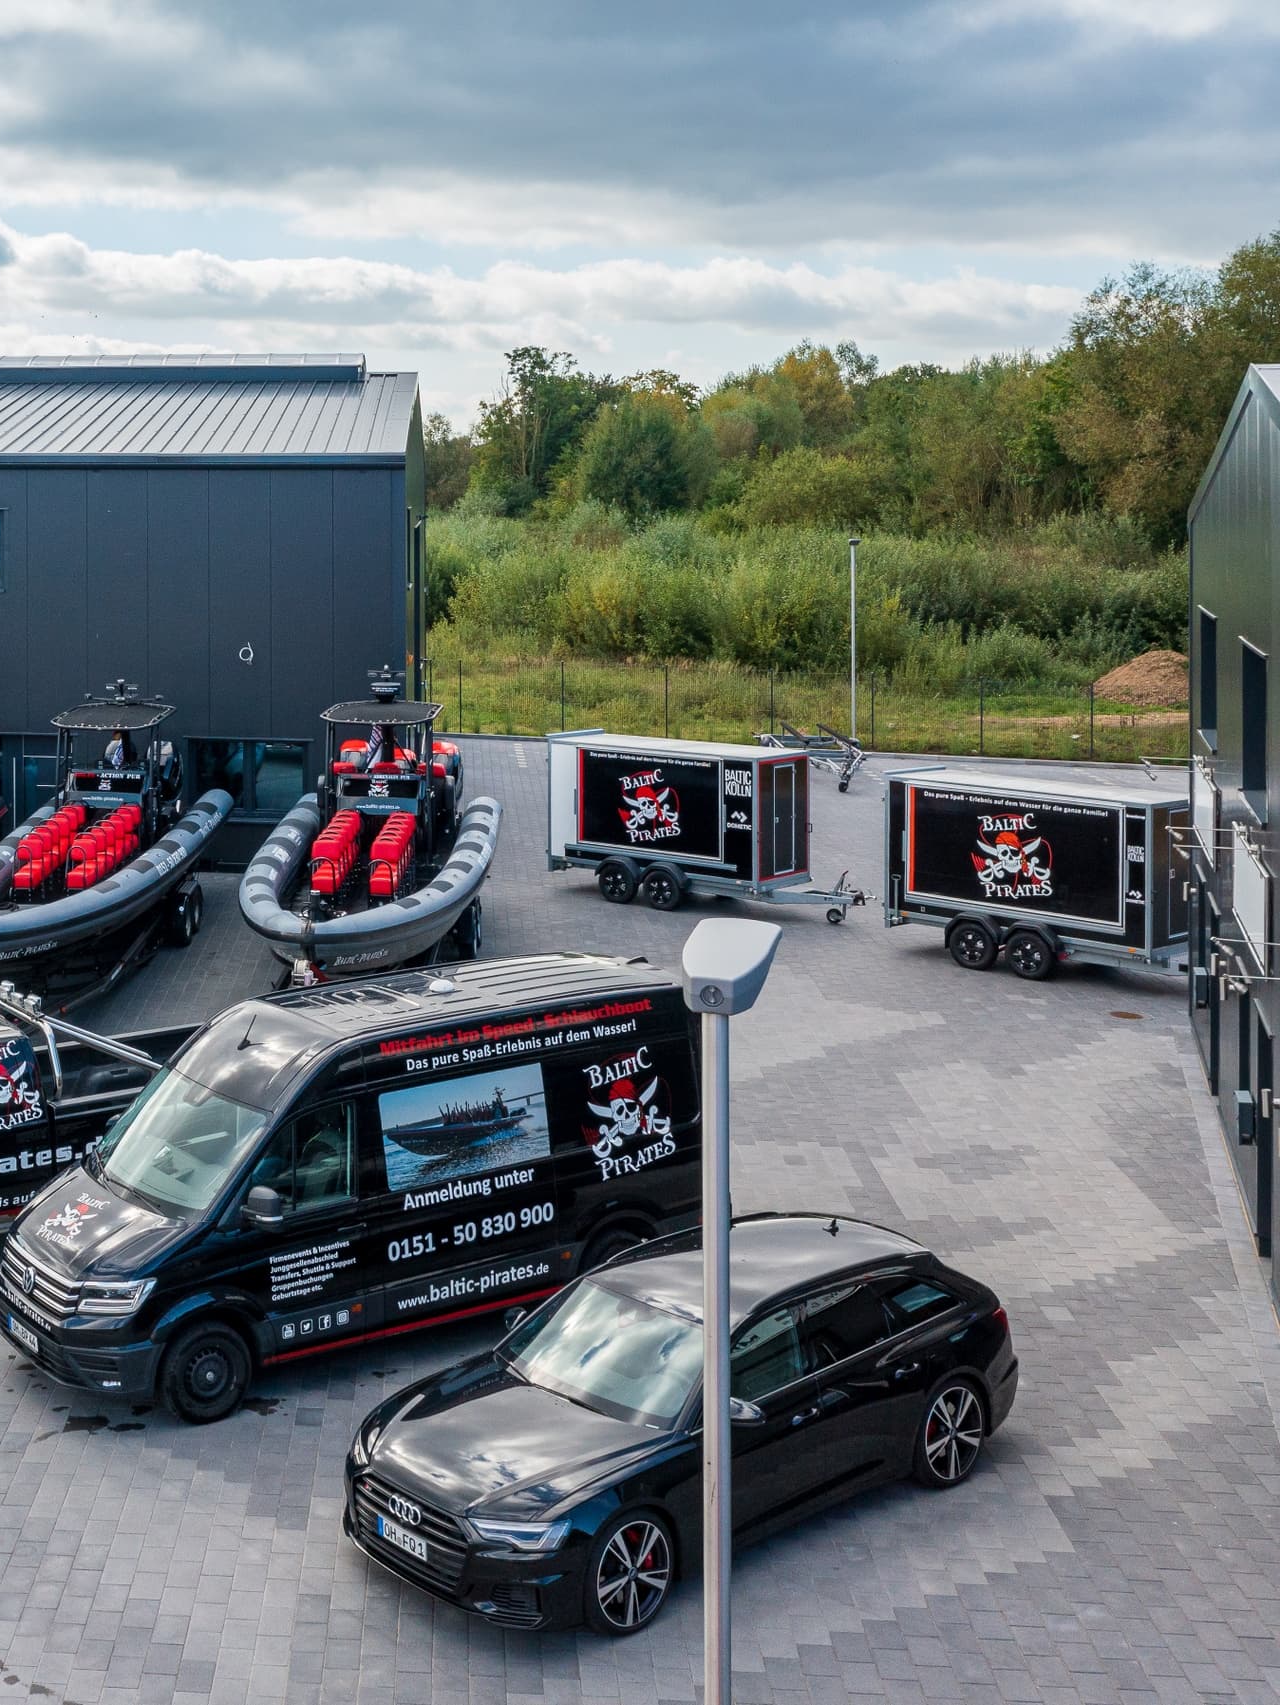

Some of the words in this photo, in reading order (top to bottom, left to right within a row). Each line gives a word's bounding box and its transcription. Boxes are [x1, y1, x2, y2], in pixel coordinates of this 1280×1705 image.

[618, 768, 665, 791] BALTIC
[724, 769, 752, 785] BALTIC
[924, 790, 935, 798] Das
[936, 792, 949, 800] pure
[1019, 801, 1041, 810] Wasser
[1052, 804, 1062, 812] die
[1083, 808, 1108, 817] Familie!
[626, 822, 681, 843] PIRATES
[977, 813, 1037, 832] BALTIC
[979, 880, 1053, 899] PIRATES
[379, 1033, 454, 1057] Mitfahrt
[457, 1029, 480, 1043] im
[482, 1017, 534, 1040] Speed
[544, 998, 652, 1028] Schlauchboot
[406, 1056, 428, 1071] Das
[432, 1052, 460, 1069] pure
[462, 1036, 542, 1062] Spaß-Erlebnis
[544, 1030, 564, 1046] auf
[566, 1027, 590, 1044] dem
[593, 1018, 637, 1038] Wasser!
[582, 1045, 653, 1090] BALTIC
[595, 1132, 677, 1182] PIRATES
[12, 1190, 36, 1205] auf
[403, 1178, 492, 1211] Anmeldung
[494, 1168, 535, 1189] unter
[387, 1232, 436, 1262] 0151
[453, 1222, 477, 1245] 50
[481, 1212, 516, 1238] 830
[520, 1202, 554, 1228] 900
[269, 1249, 312, 1265] Firmenevents
[318, 1240, 350, 1253] Incentives
[270, 1251, 339, 1274] Junggesellenabschied
[302, 1265, 325, 1276] Shuttle
[331, 1257, 357, 1270] Support
[271, 1272, 334, 1292] Gruppenbuchungen
[272, 1287, 311, 1302] Geburtstage
[311, 1284, 324, 1292] etc.
[398, 1263, 550, 1311] www.baltic-pirates.de
[384, 1523, 397, 1542] OH
